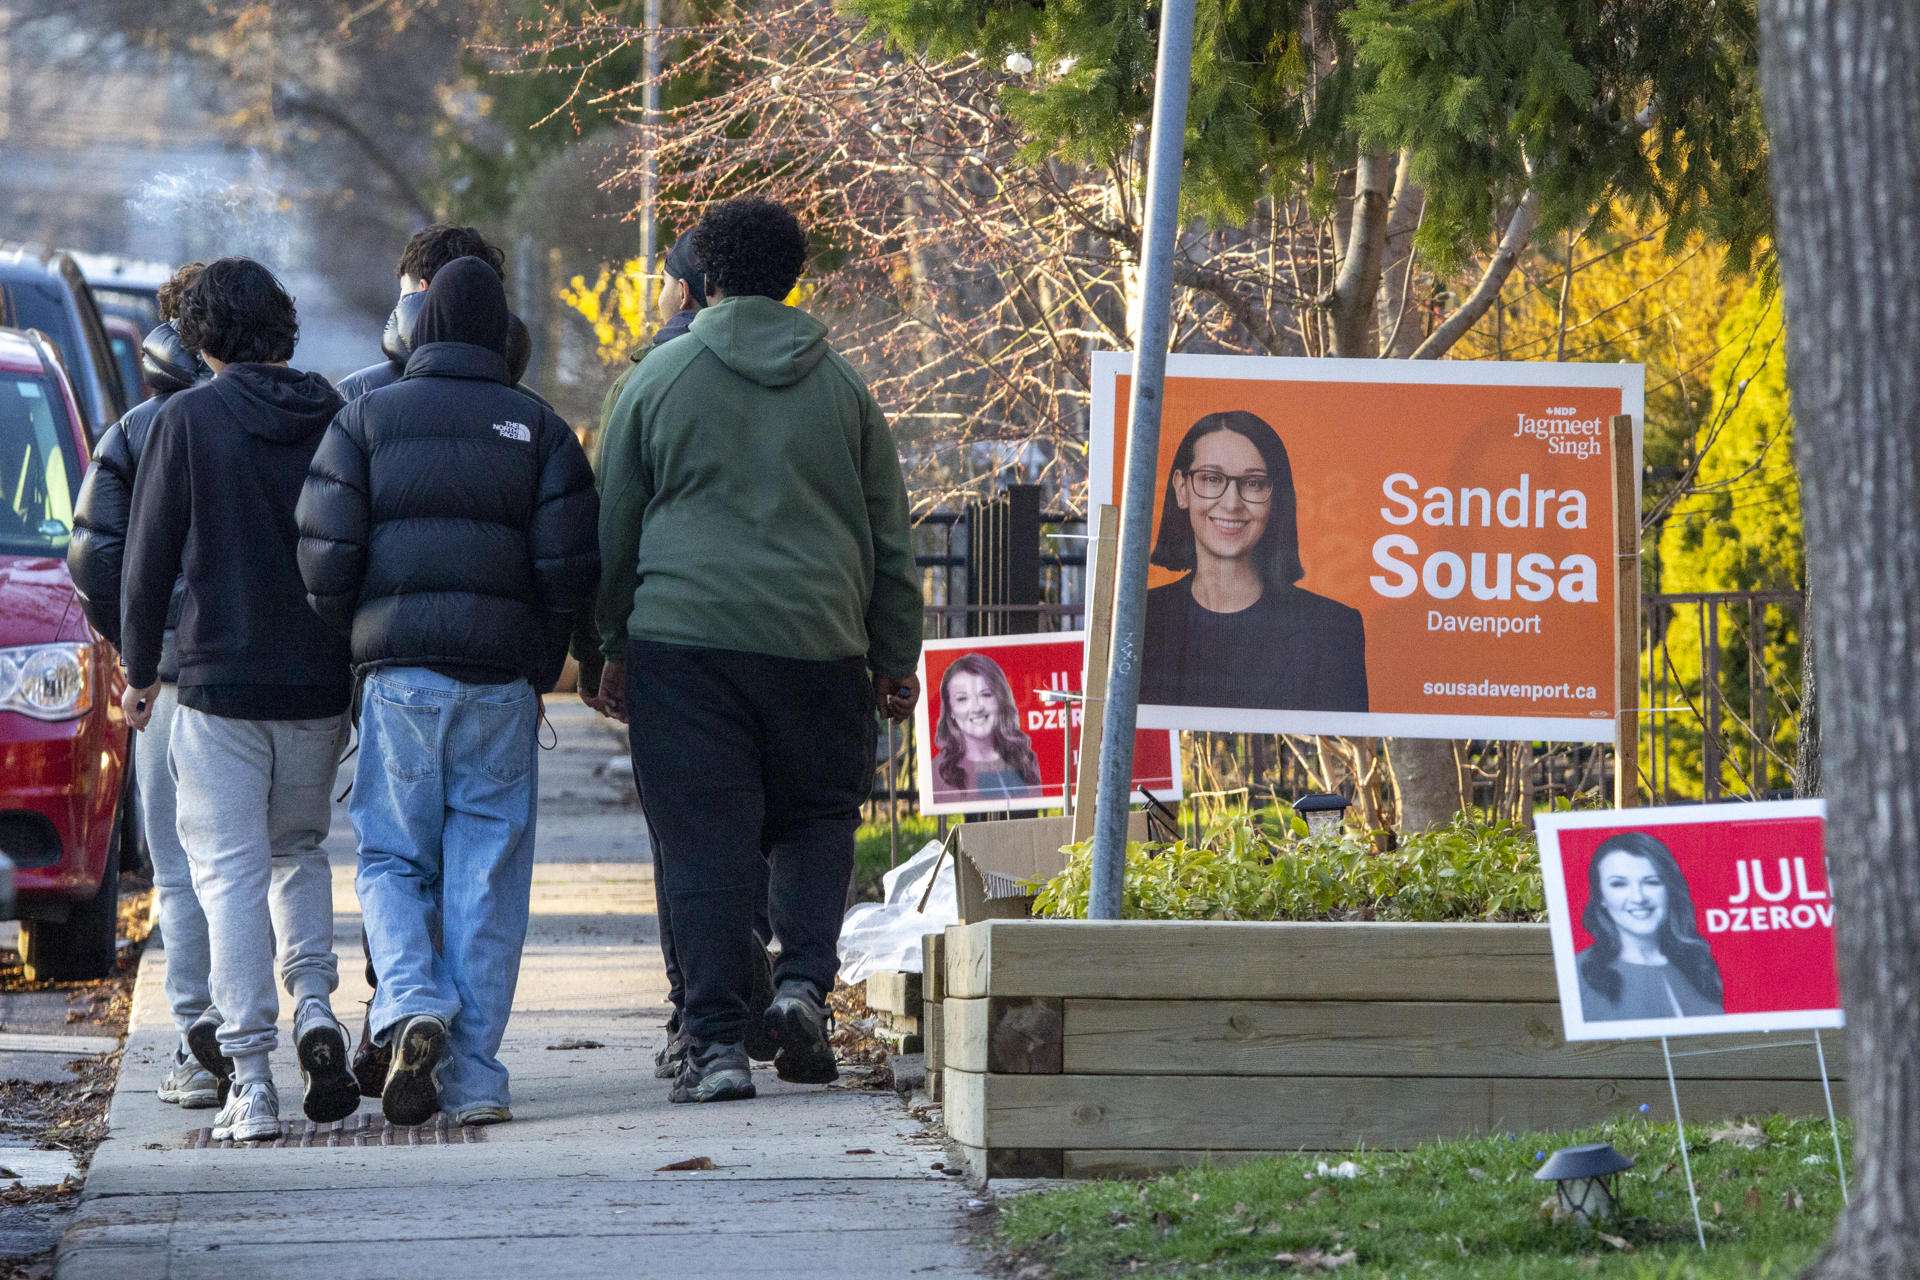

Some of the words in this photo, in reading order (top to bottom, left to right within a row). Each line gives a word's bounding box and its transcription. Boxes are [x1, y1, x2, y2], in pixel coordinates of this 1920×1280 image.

[1553, 407, 1577, 416] NDP
[492, 423, 520, 435] NORTH
[499, 429, 520, 440] FACE
[504, 420, 520, 429] THE
[1513, 413, 1602, 440] Jagmeet
[1548, 436, 1601, 460] Singh
[1380, 472, 1588, 529] Sandra
[1369, 534, 1599, 603] Sousa
[1426, 610, 1541, 638] Davenport
[1423, 680, 1597, 701] sousadavenport.ca
